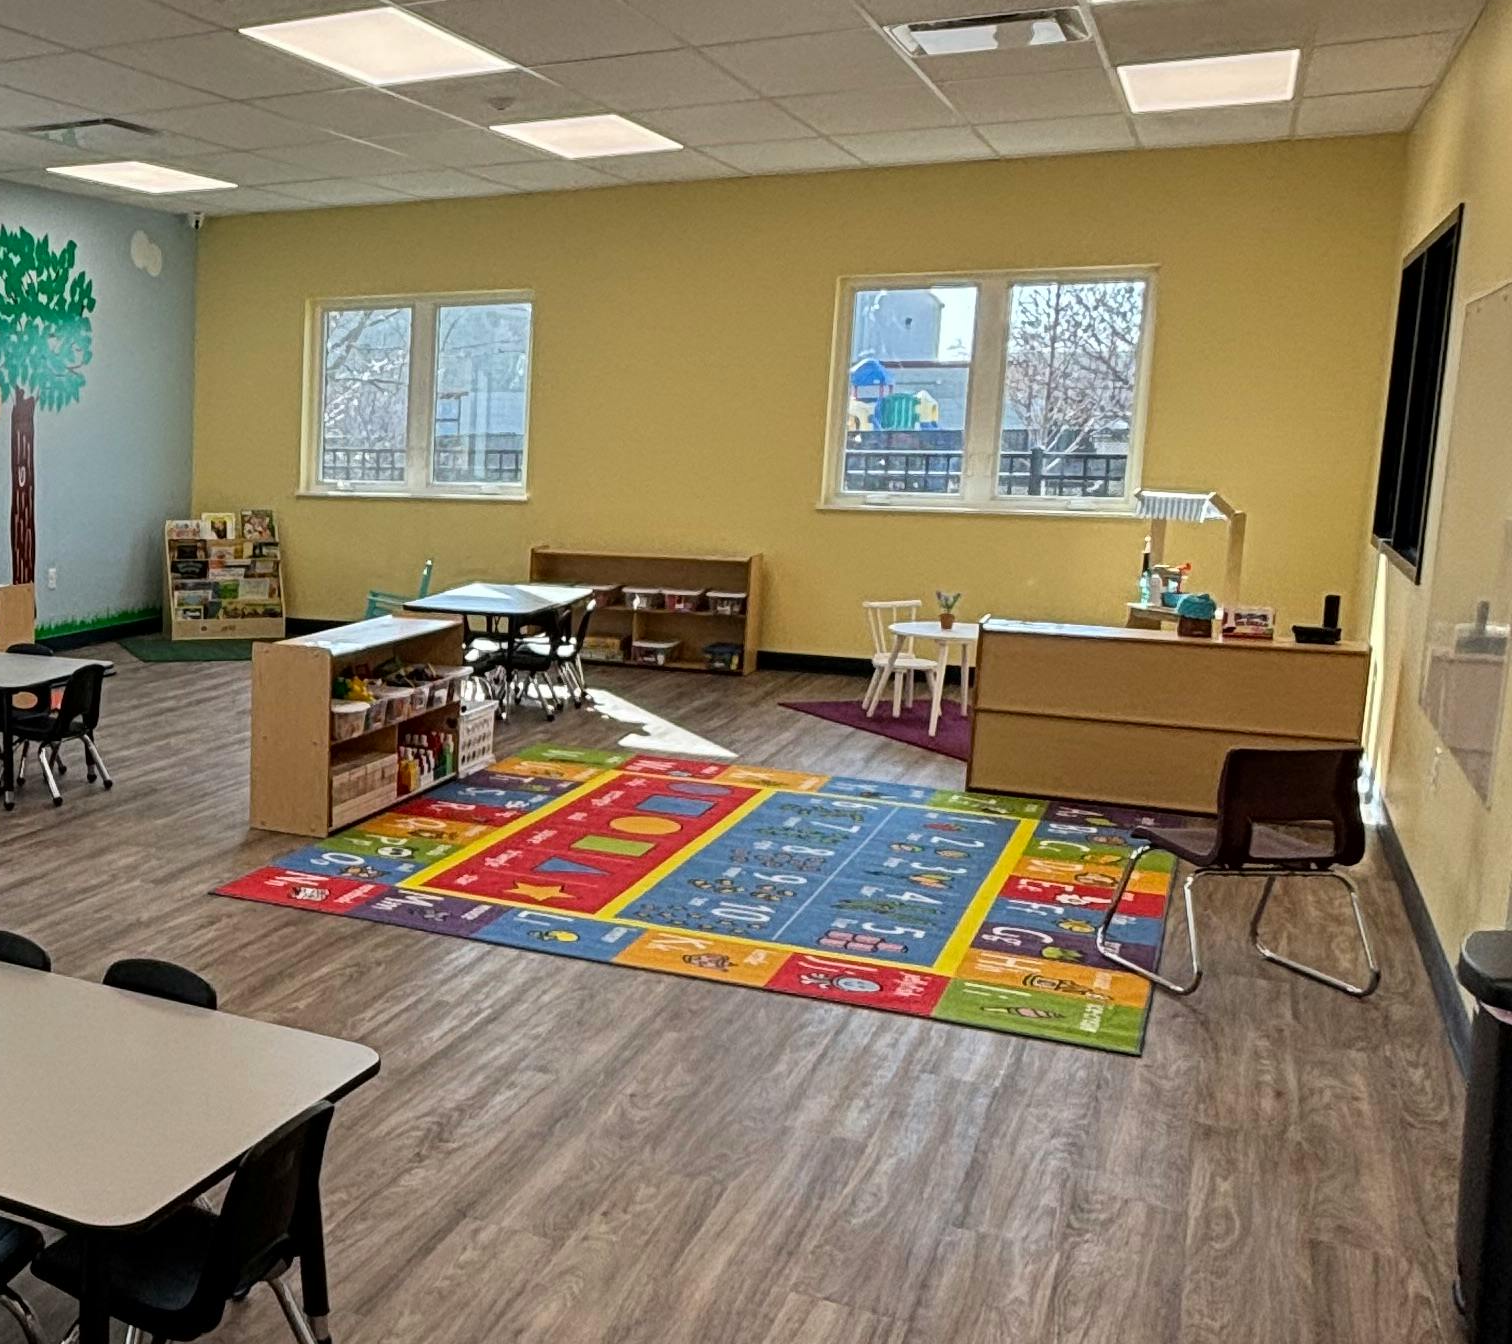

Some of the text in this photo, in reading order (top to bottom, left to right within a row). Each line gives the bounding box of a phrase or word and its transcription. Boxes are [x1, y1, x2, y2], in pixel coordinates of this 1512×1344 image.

[832, 801, 878, 810] 6
[811, 821, 860, 833] 7
[930, 836, 984, 847] 2
[782, 845, 834, 856] 8
[311, 853, 365, 865] Oo
[910, 862, 967, 873] 3
[264, 870, 330, 887] Nn
[754, 873, 807, 884] 9
[1017, 878, 1074, 893] Ee
[372, 890, 444, 910] Mm
[886, 892, 942, 904] 4
[711, 902, 774, 922] 10
[1008, 900, 1064, 915] Ff
[514, 911, 574, 926] Ll
[862, 922, 925, 938] 5
[982, 927, 1053, 946] Gg
[798, 956, 877, 975] Jj
[975, 951, 1043, 973] Hh
[963, 982, 1032, 999] Ii
